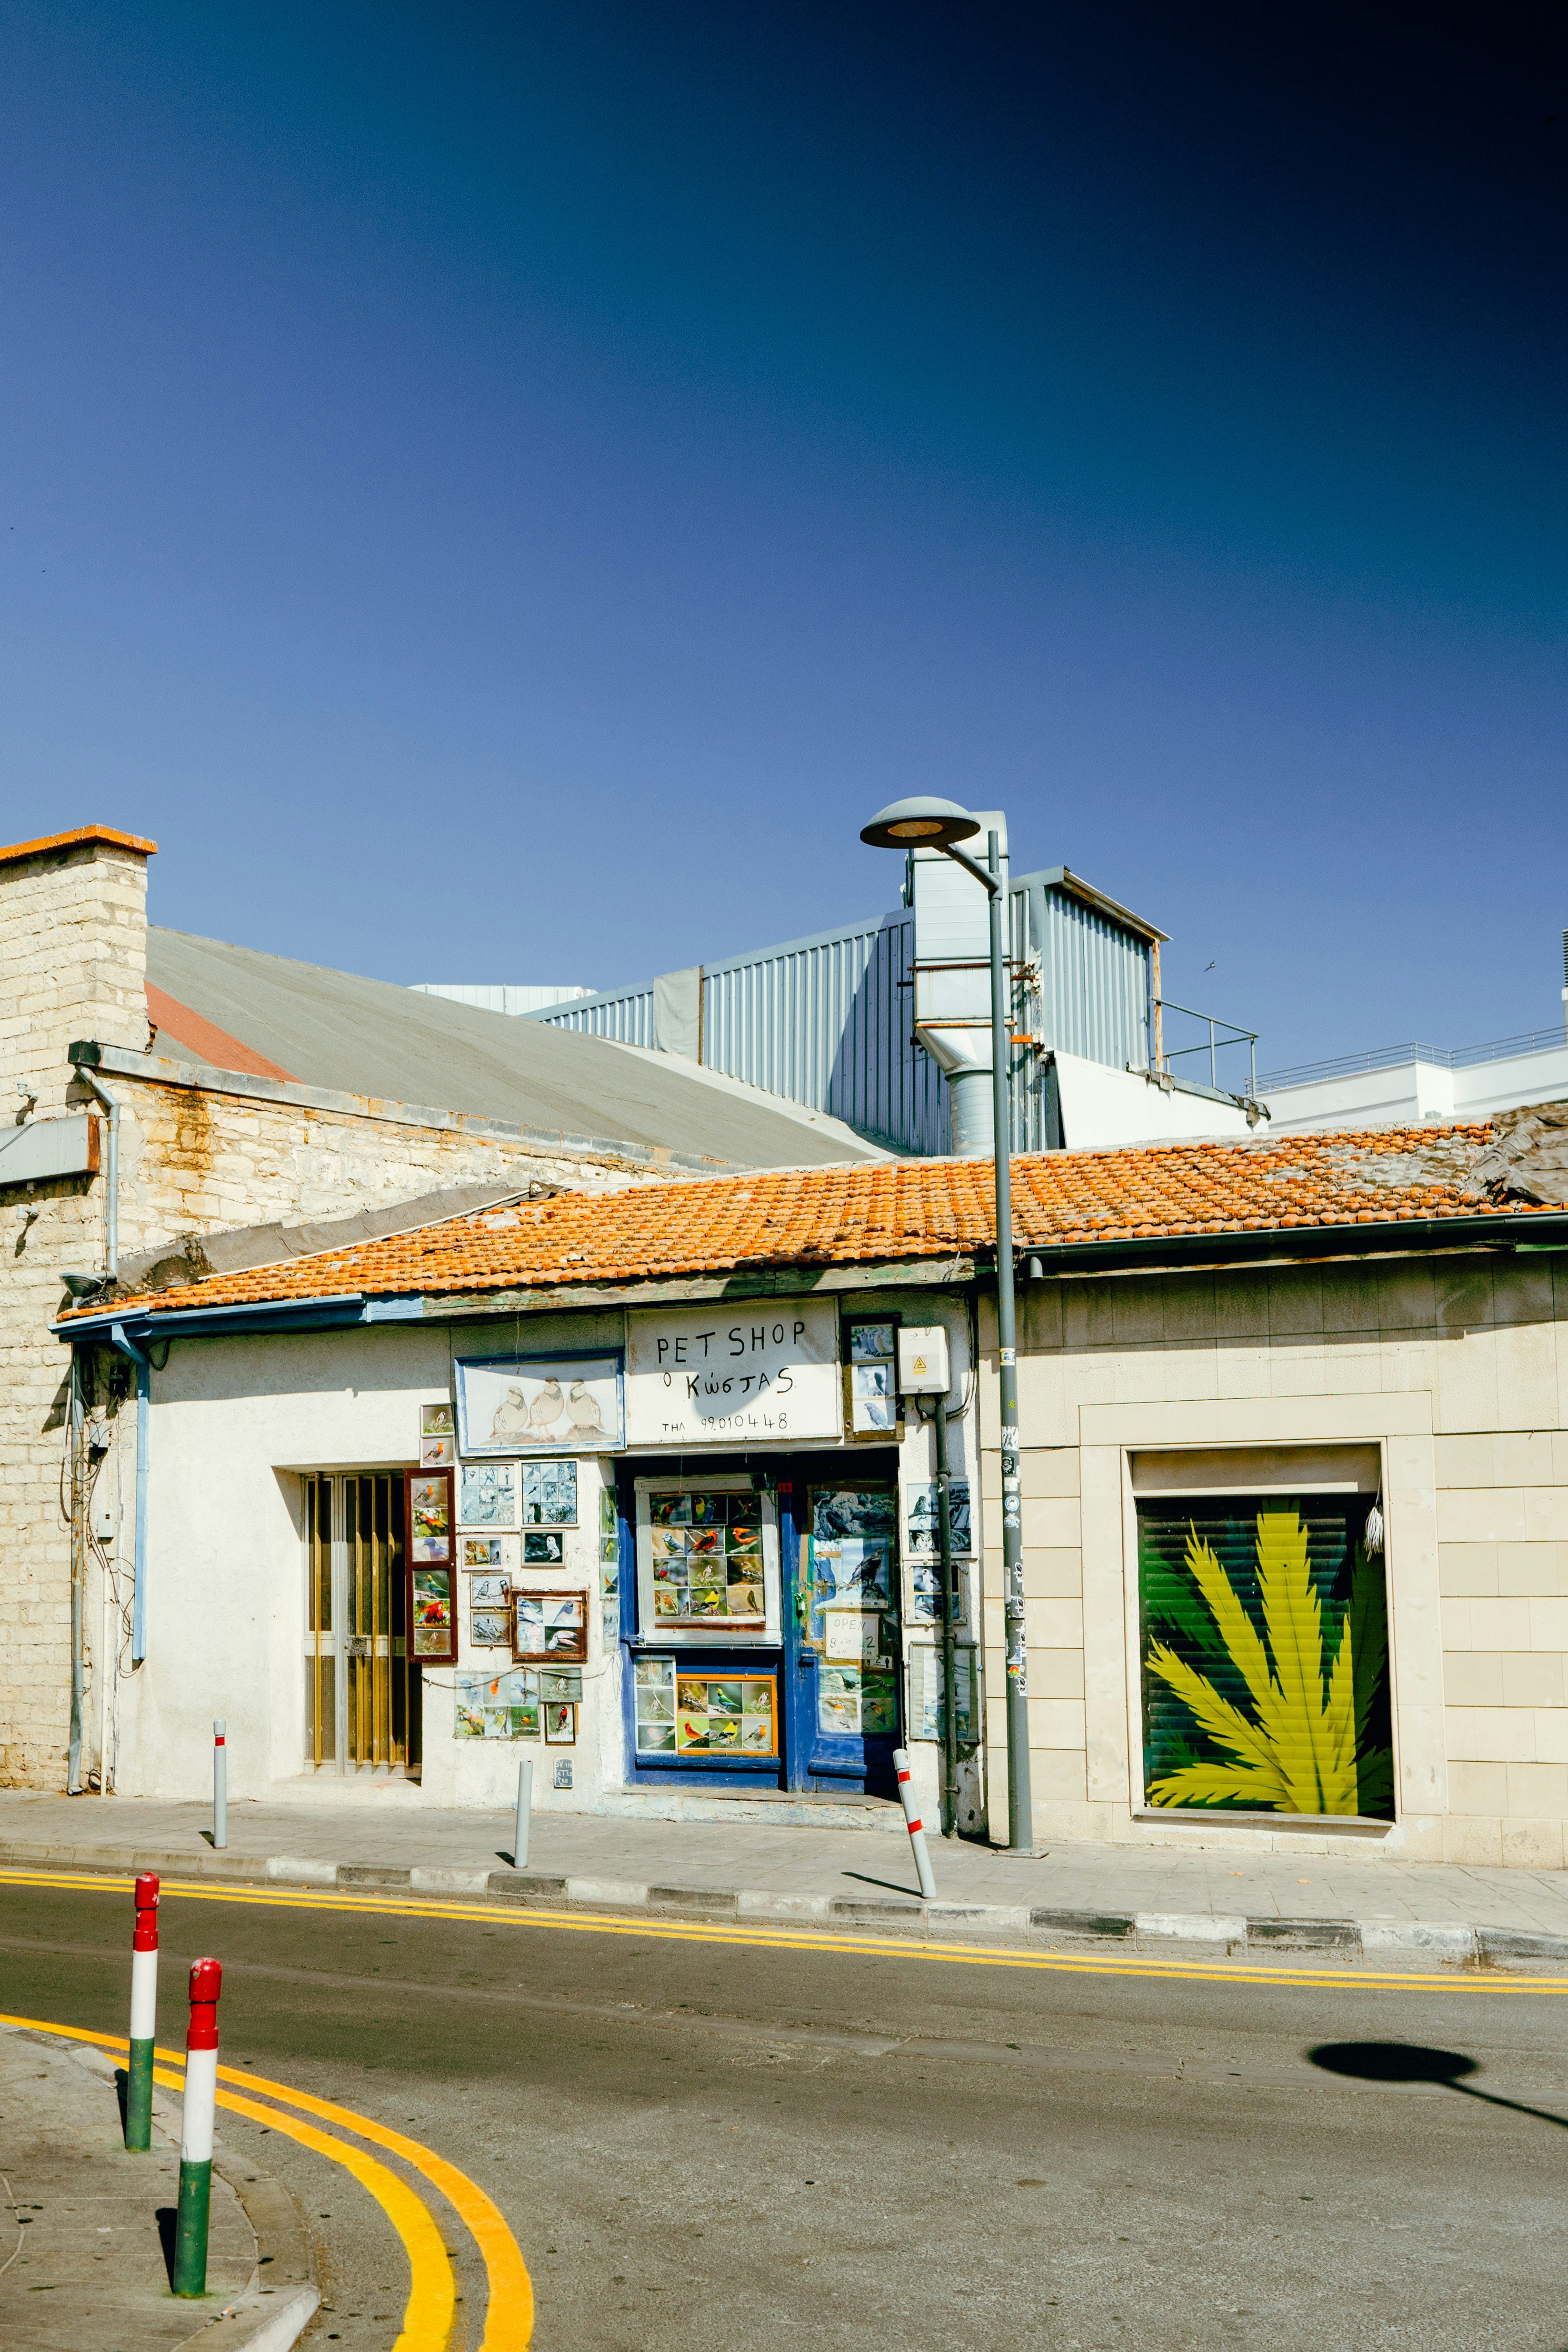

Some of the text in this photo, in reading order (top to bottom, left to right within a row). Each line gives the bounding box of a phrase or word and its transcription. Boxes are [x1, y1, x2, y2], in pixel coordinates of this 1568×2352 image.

[657, 1321, 805, 1364] PET SHOP
[780, 1484, 790, 1493] 14
[834, 1618, 866, 1631] OPEN
[866, 1636, 875, 1648] 2
